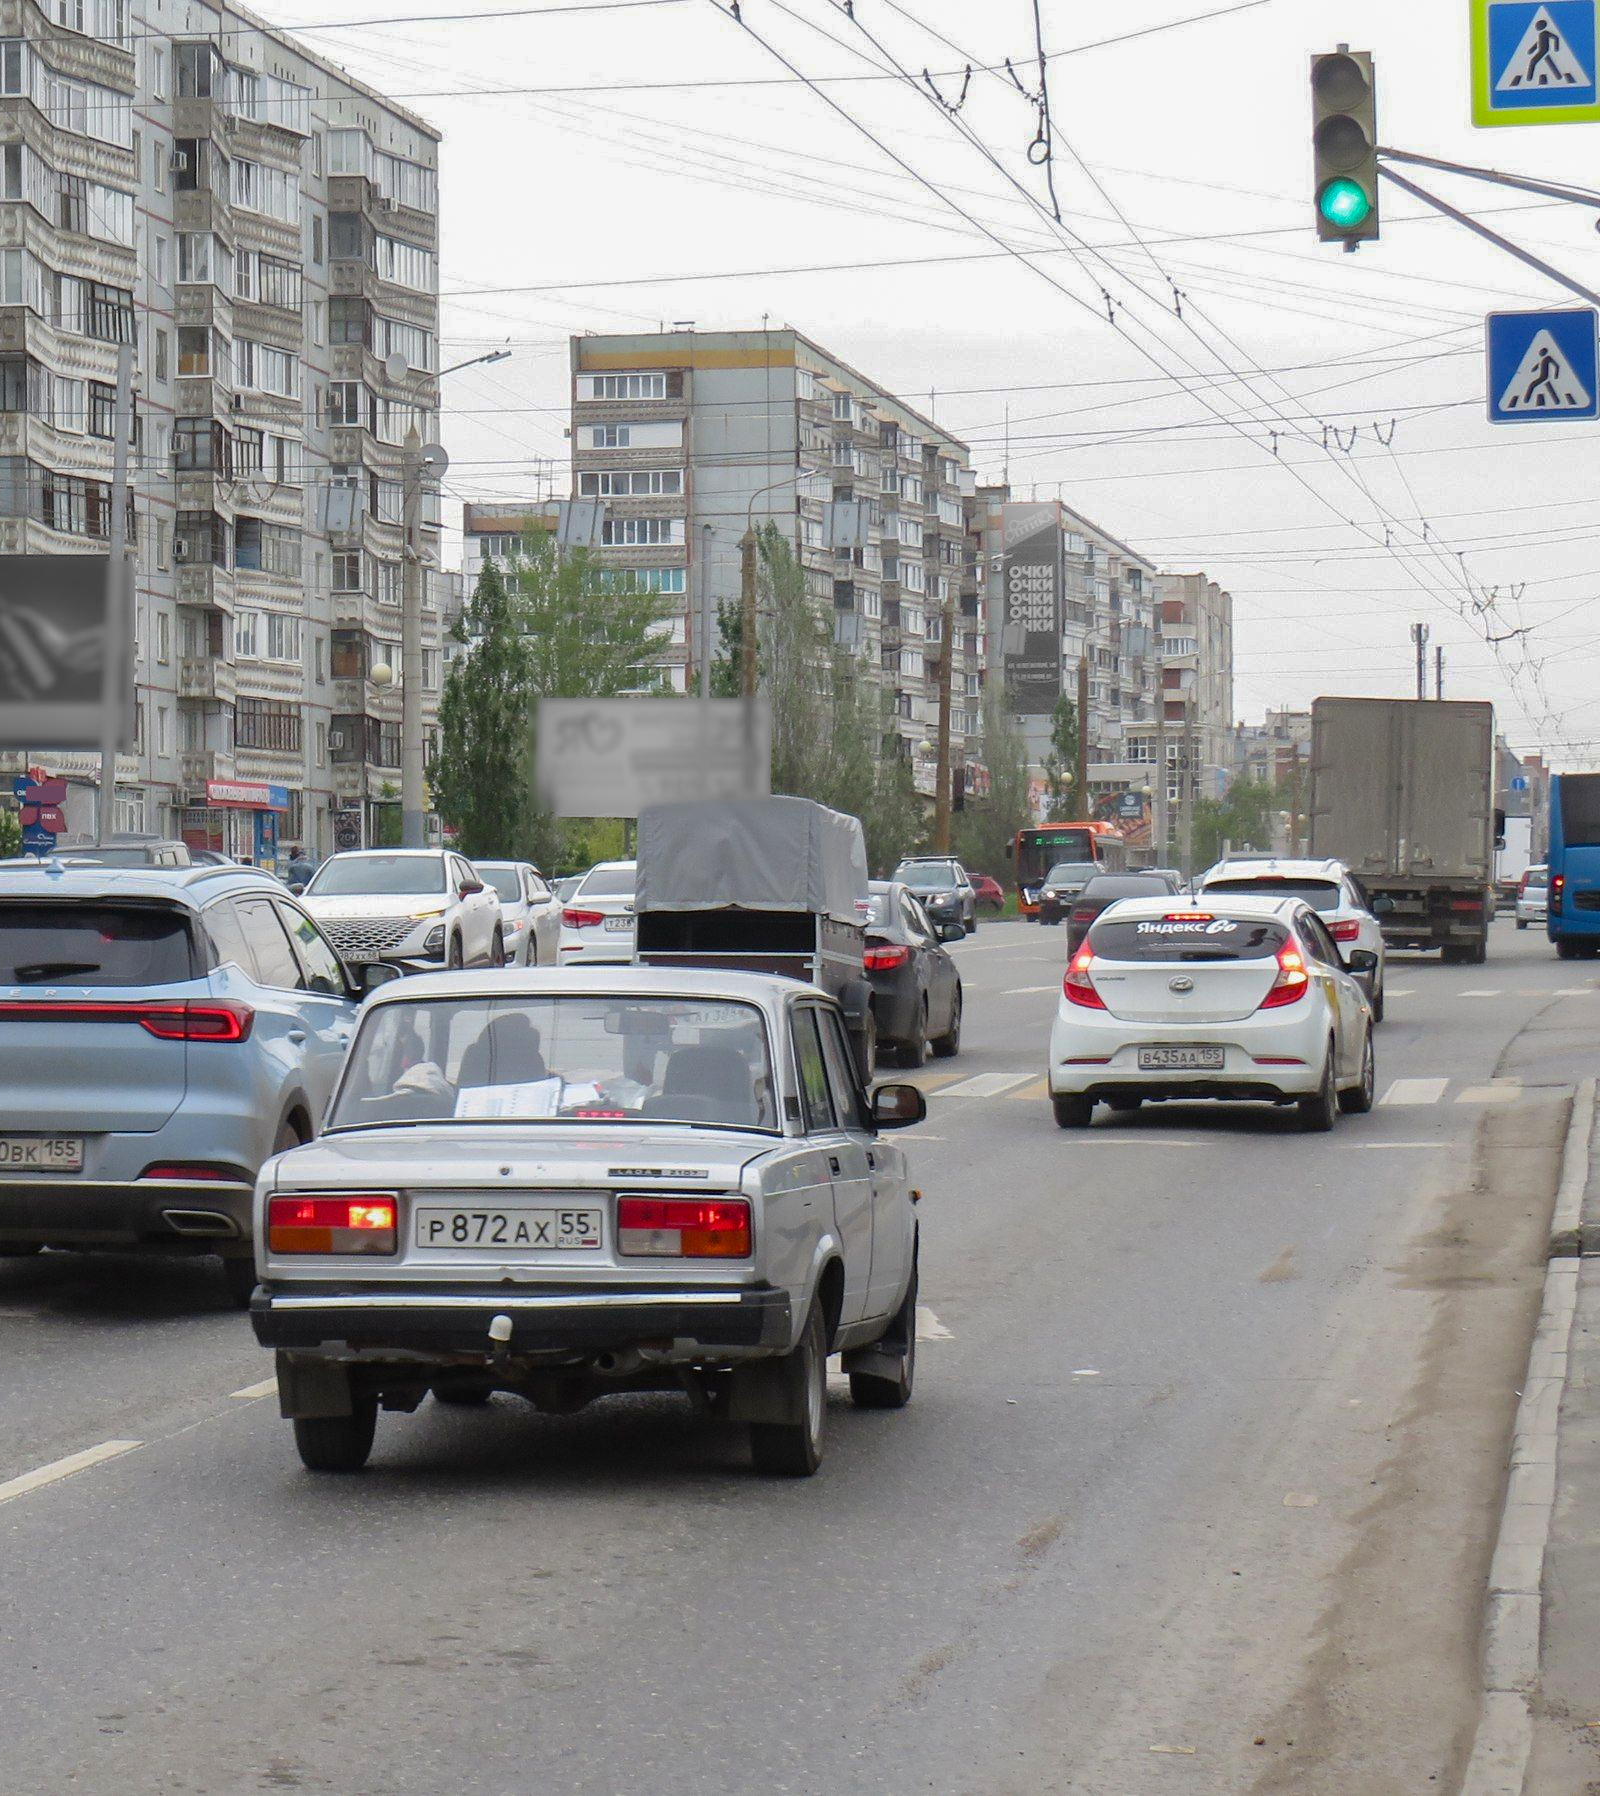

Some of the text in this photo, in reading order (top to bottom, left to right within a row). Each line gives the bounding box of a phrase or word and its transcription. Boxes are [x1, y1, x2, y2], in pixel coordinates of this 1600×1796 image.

[1009, 565, 1053, 578] ОЧКИ
[1009, 579, 1053, 592] ОЧКИ
[1009, 592, 1053, 605] ОЧКИ
[1009, 606, 1053, 619] ОЧКИ
[1136, 919, 1238, 935] Яндекс Go
[560, 1213, 590, 1235] 55
[558, 1237, 581, 1245] RUS
